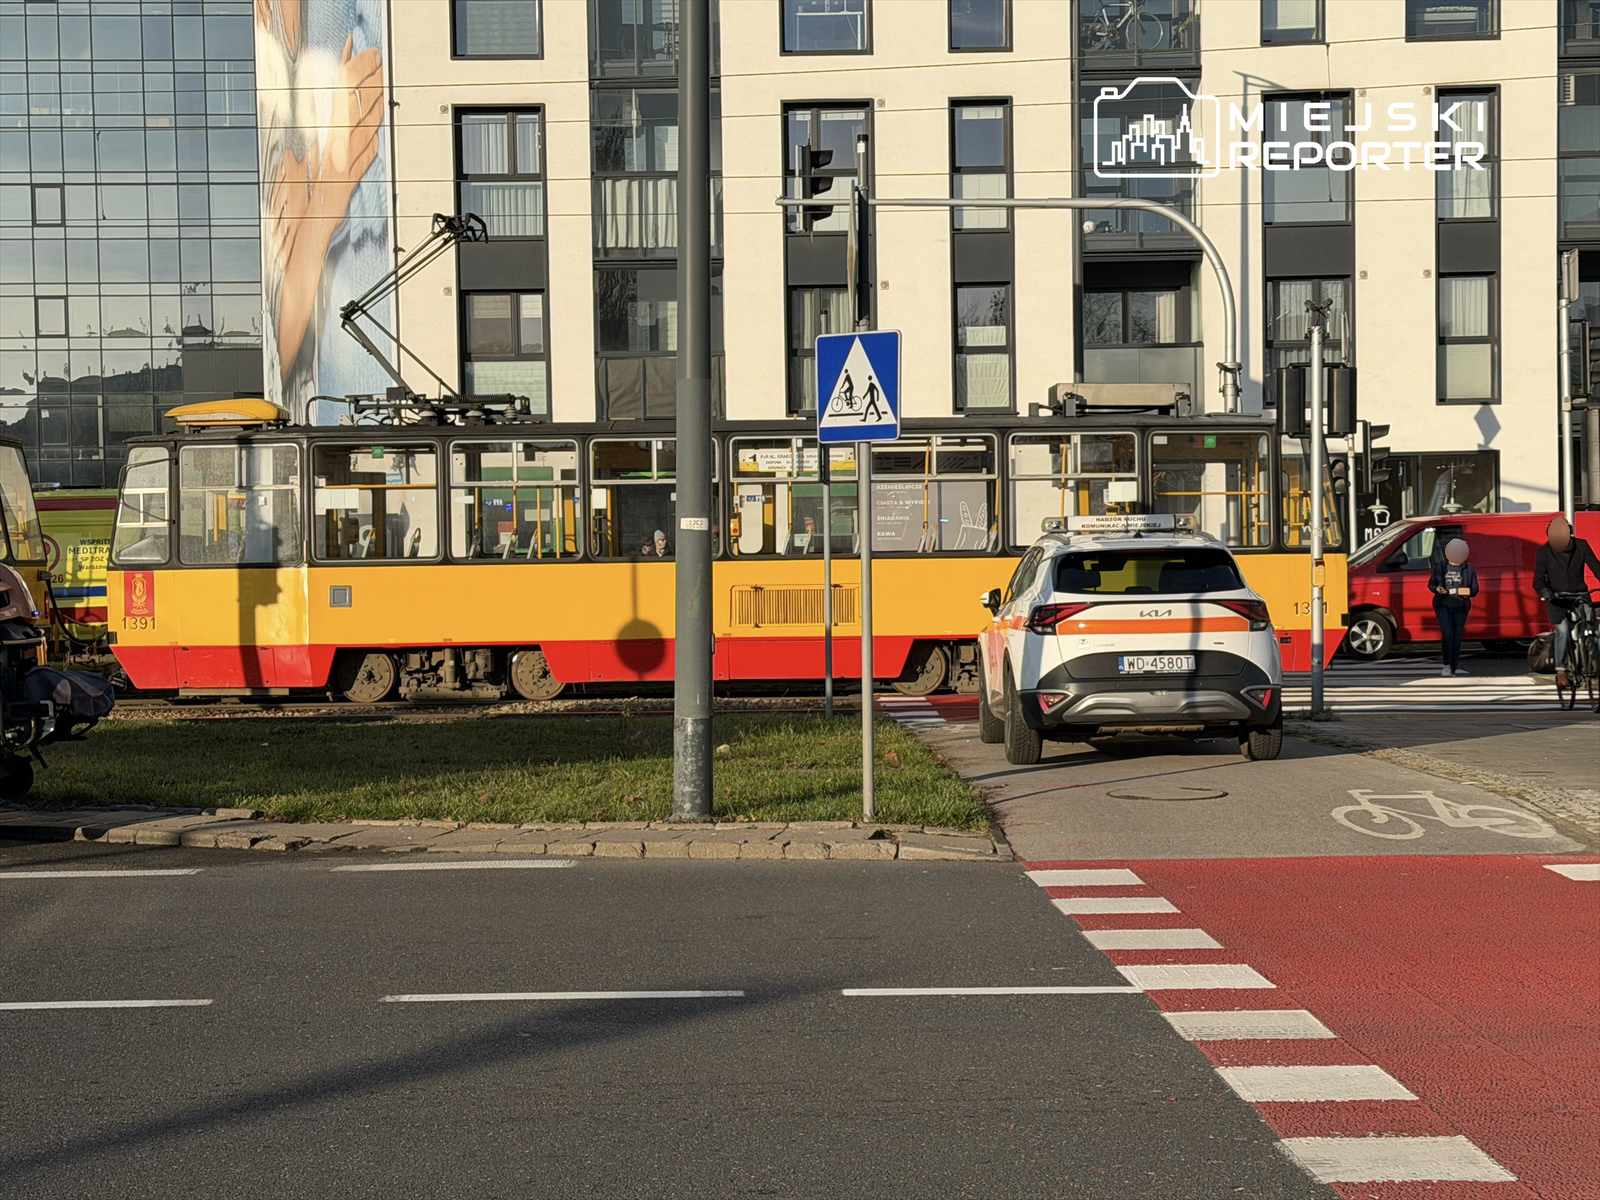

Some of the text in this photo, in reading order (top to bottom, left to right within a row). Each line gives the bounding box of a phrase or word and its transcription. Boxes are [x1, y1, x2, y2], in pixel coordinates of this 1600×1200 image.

[68, 546, 110, 555] MEDITRA
[1139, 609, 1172, 618] KIA
[1293, 601, 1328, 615] 131
[121, 616, 156, 630] 1391
[1126, 657, 1145, 671] WD
[1150, 656, 1192, 670] 4580T
